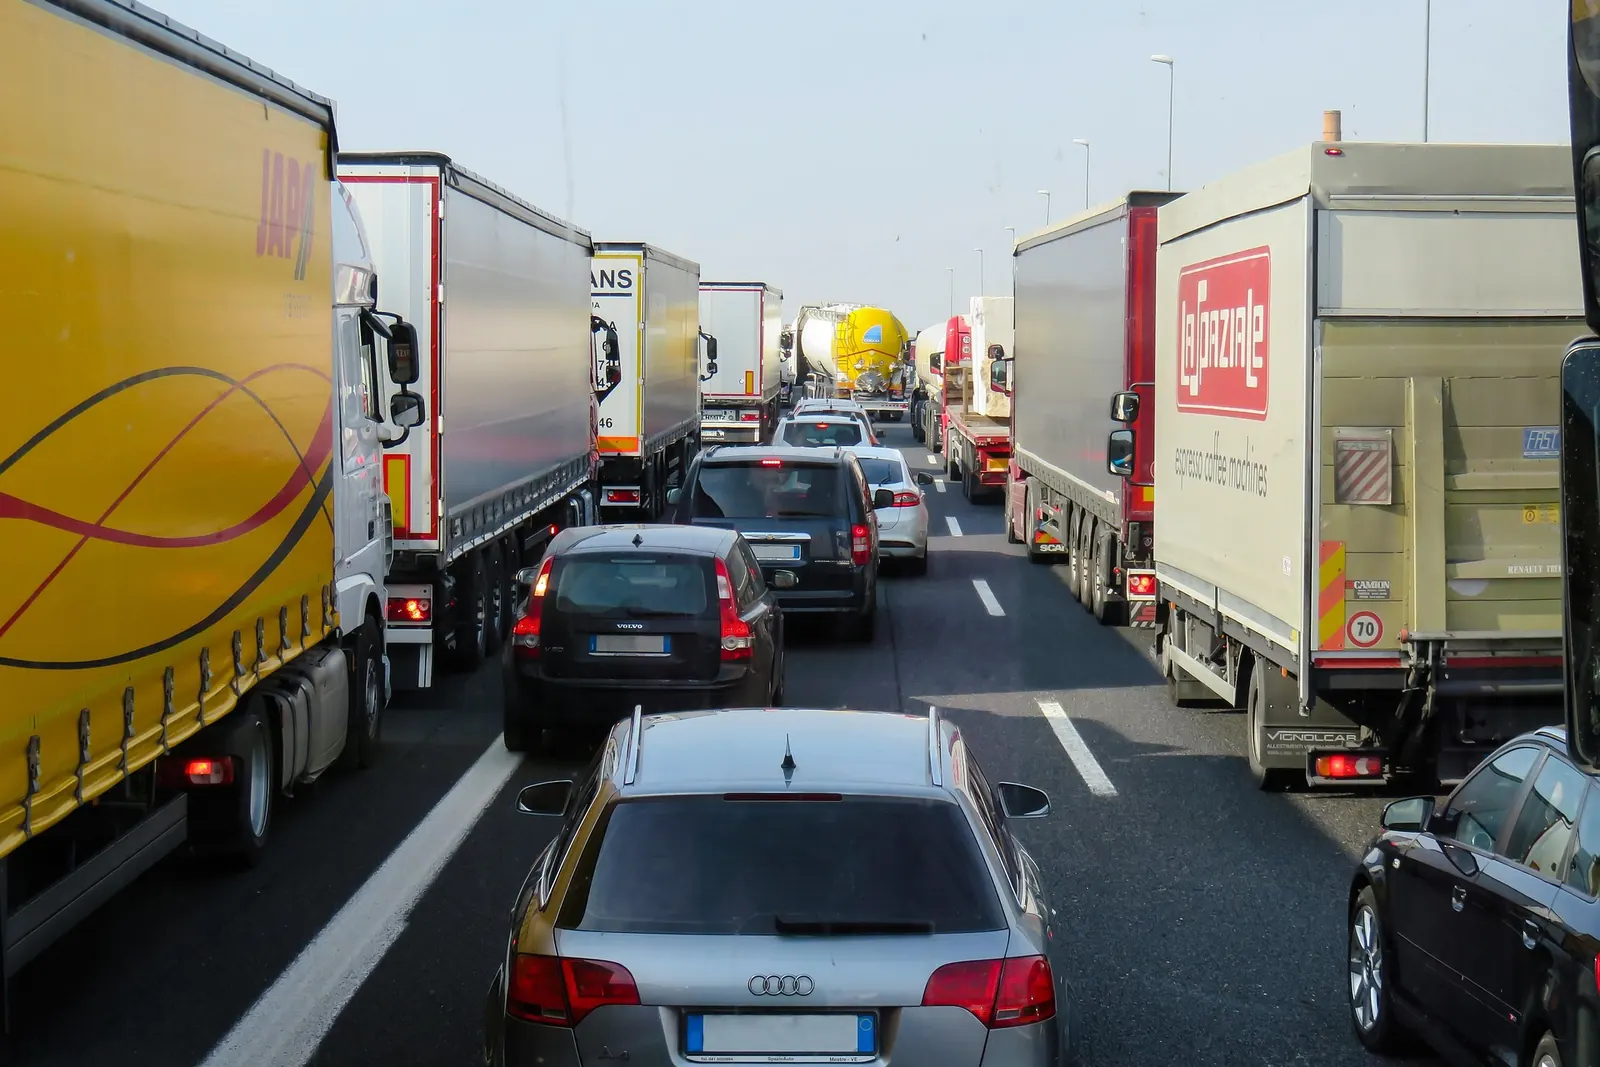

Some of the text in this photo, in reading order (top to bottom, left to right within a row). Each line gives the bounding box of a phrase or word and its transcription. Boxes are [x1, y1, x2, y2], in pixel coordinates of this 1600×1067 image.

[1175, 430, 1267, 498] espresso coffee machines
[1507, 565, 1544, 574] RENAULT
[1353, 580, 1390, 589] CAMION
[1357, 622, 1375, 637] 70
[1267, 731, 1357, 741] VIGNOLCAR
